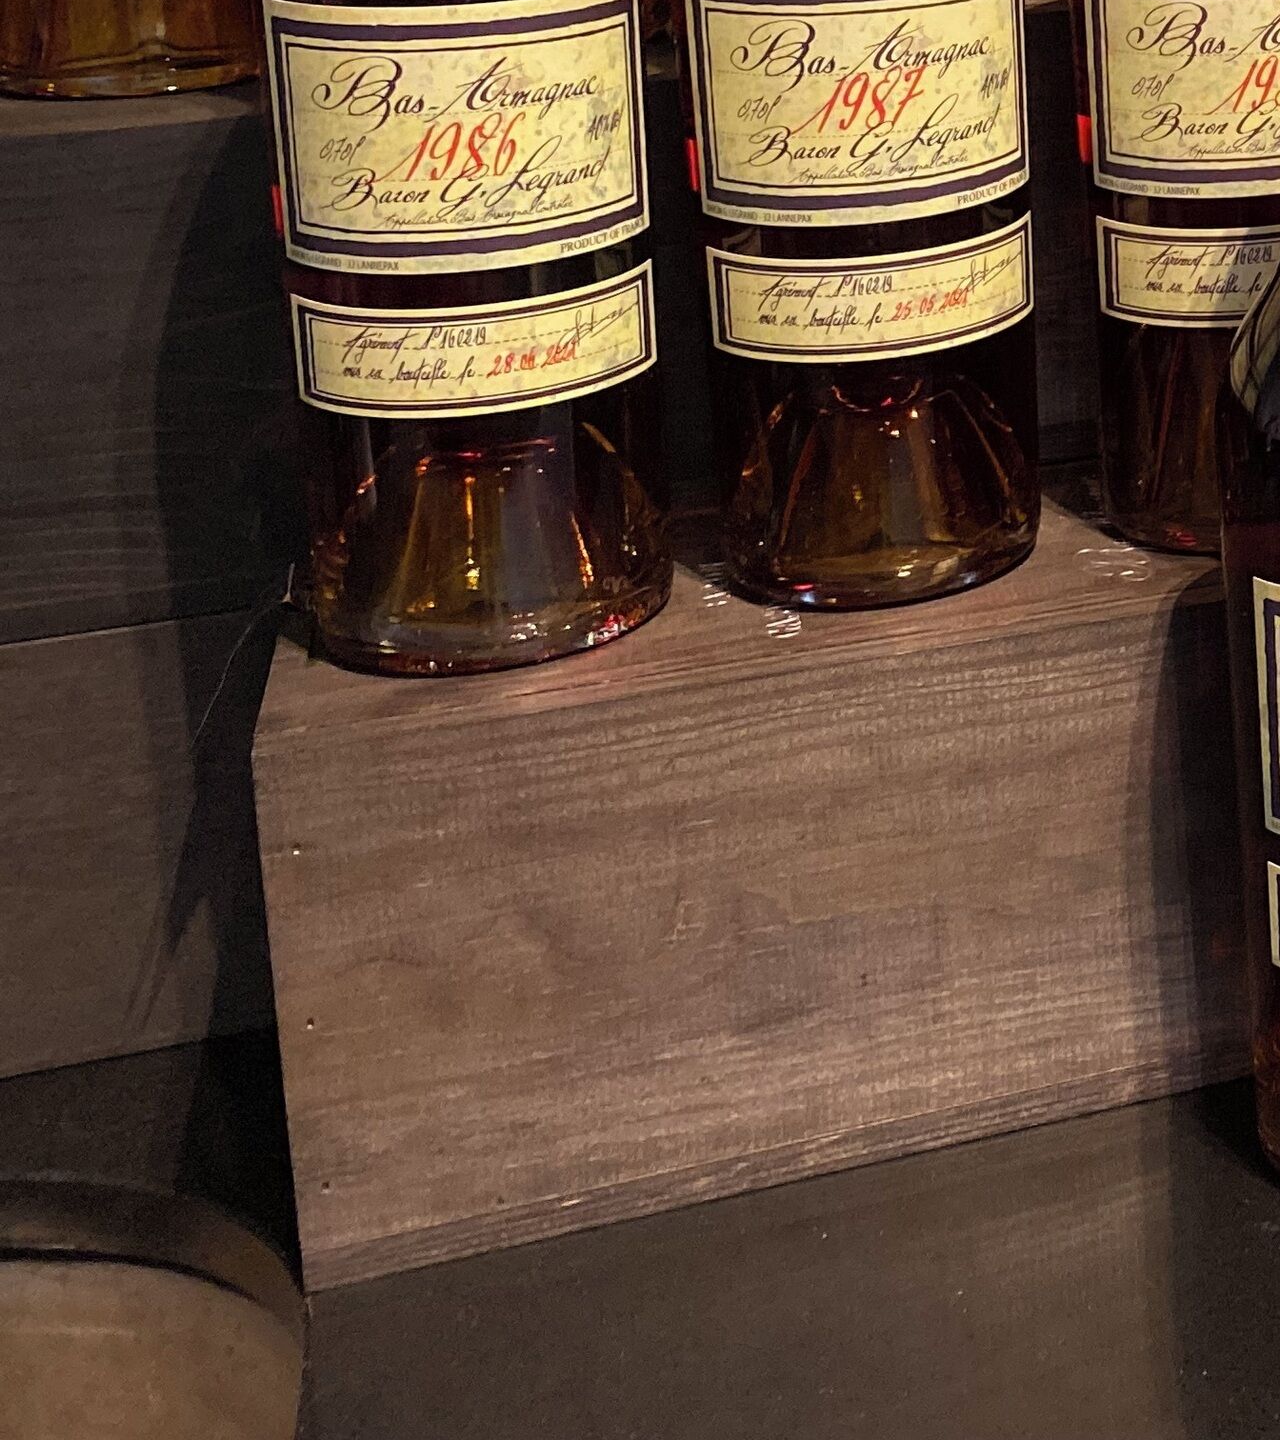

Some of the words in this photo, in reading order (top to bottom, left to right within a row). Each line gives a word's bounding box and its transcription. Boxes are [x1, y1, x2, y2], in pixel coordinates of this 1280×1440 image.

[739, 125, 839, 168] Baron
[894, 94, 1002, 163] Legrand
[802, 65, 929, 136] 1987
[1132, 102, 1228, 144] Baron
[321, 167, 430, 212] Baron
[492, 135, 612, 208] Legrand
[381, 111, 527, 184] 1986
[957, 185, 997, 206] PRODUCT
[998, 181, 1009, 196] OF
[560, 231, 608, 255] PRODUCT
[608, 227, 621, 244] OF
